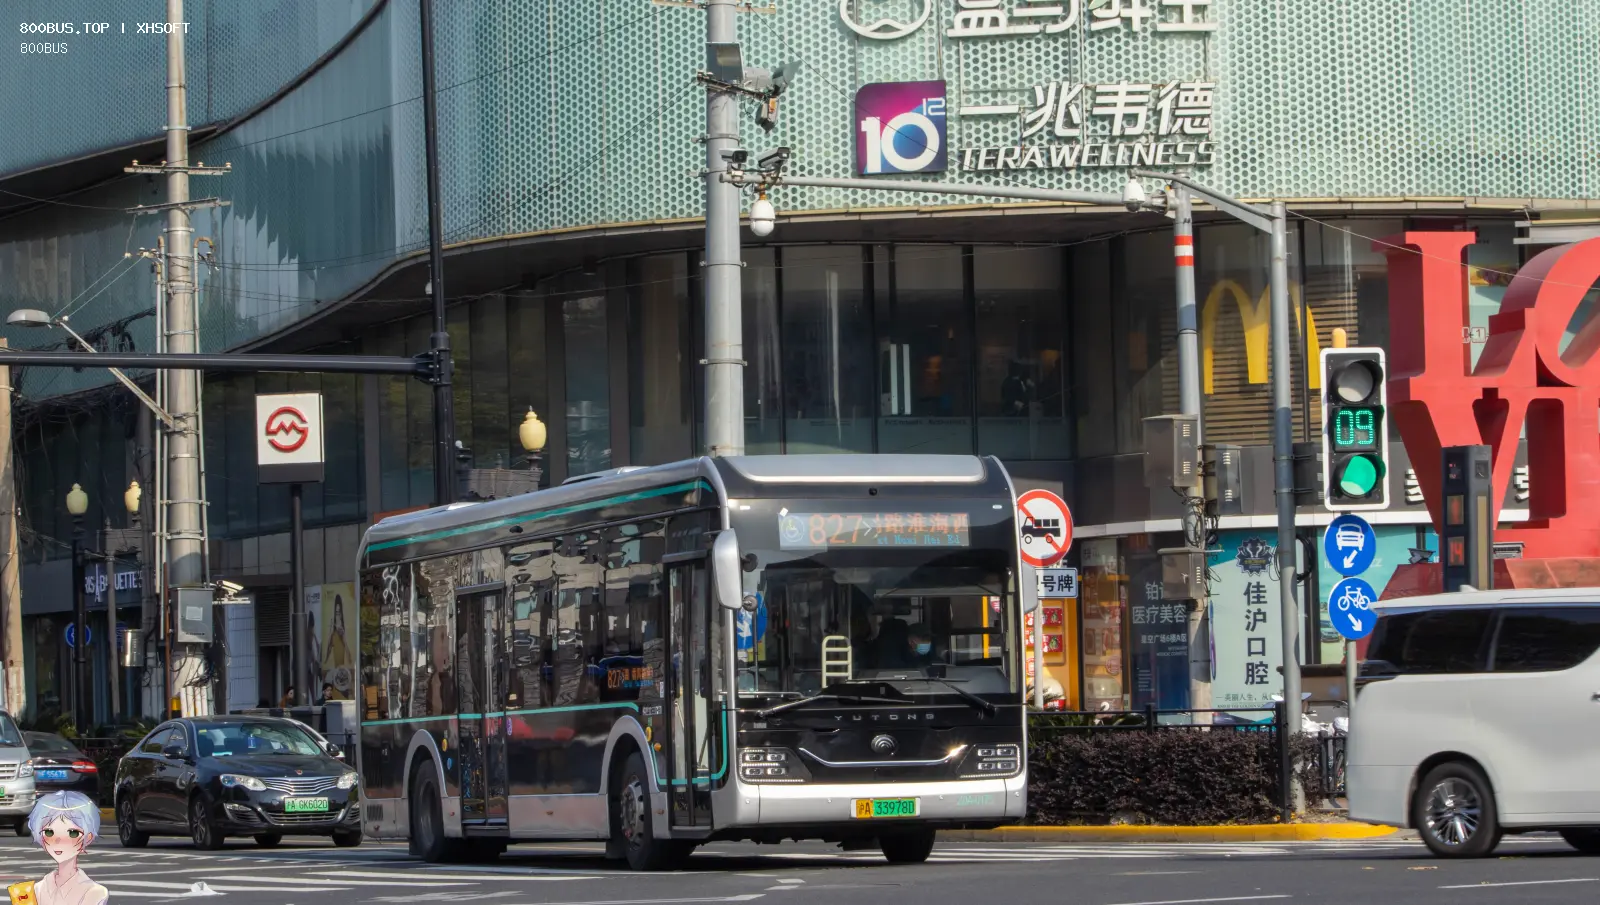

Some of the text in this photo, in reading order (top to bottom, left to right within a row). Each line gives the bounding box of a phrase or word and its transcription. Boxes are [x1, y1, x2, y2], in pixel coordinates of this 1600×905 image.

[959, 80, 1216, 138] 一兆韦德
[961, 141, 1216, 171] TERAWELLNESS
[1335, 410, 1374, 445] 09
[809, 514, 863, 545] 827
[100, 571, 138, 592] BUETTE
[1036, 574, 1074, 592] 号牌
[1132, 604, 1187, 624] 医疗美容
[1243, 581, 1269, 685] 佳沪口腔
[607, 669, 621, 688] 827
[834, 713, 935, 721] YUTONG
[858, 801, 915, 814] 沪A 33978D
